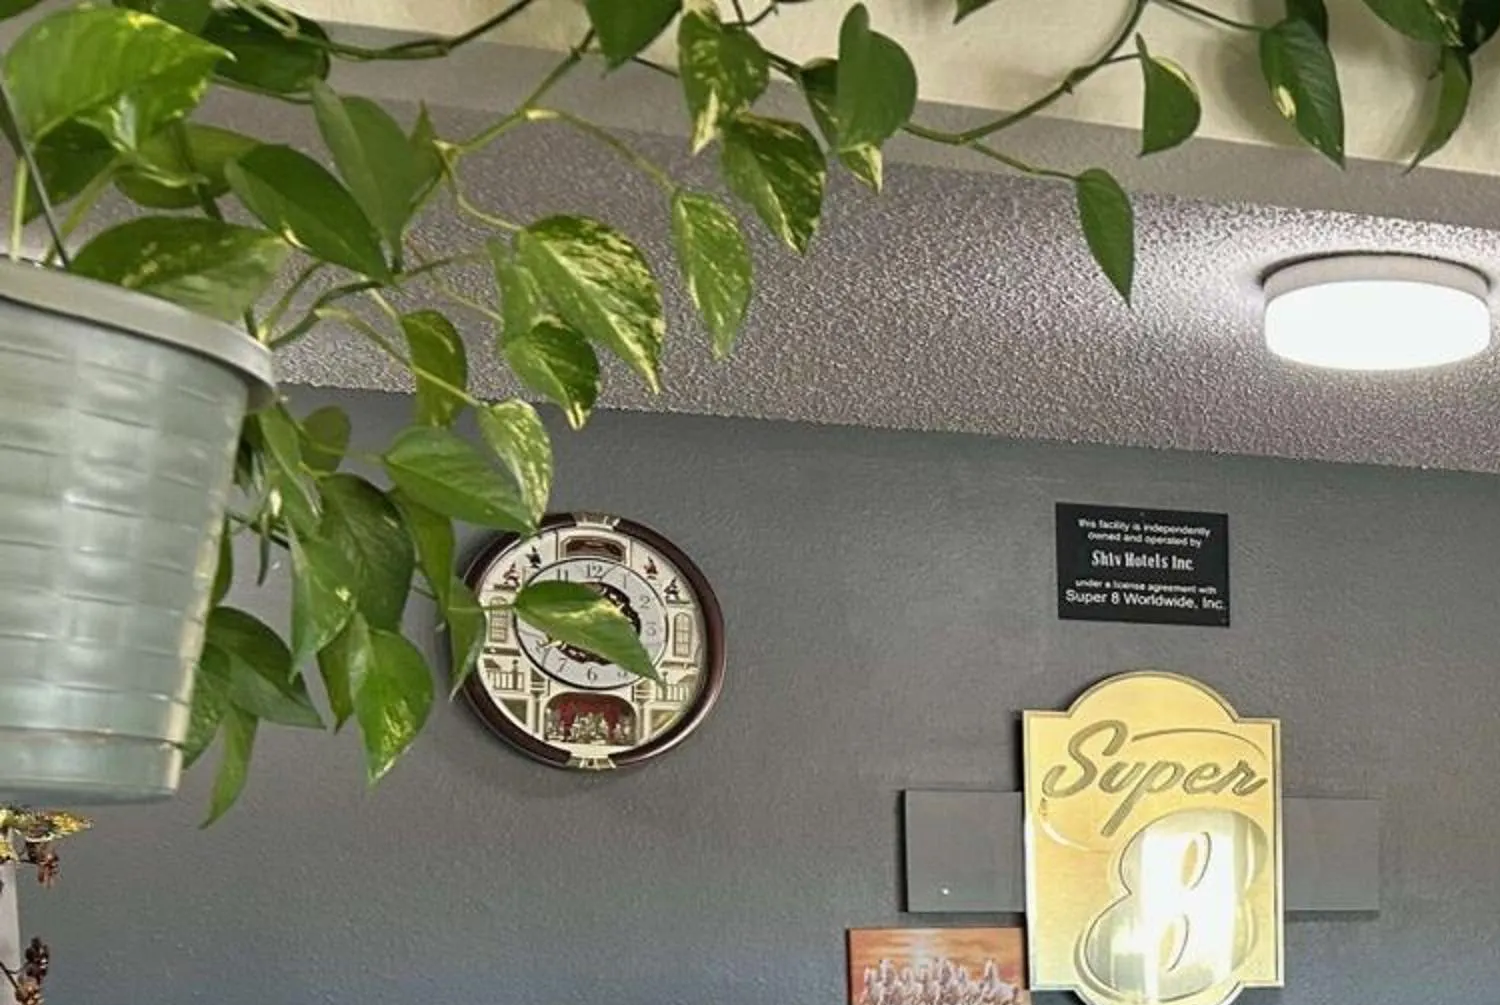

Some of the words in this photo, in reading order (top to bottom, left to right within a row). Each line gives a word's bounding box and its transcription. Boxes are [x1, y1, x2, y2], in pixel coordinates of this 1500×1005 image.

[1099, 519, 1129, 532] facility
[1132, 522, 1142, 531] is
[1143, 523, 1211, 538] independently
[1087, 531, 1121, 541] owned
[1123, 533, 1143, 543] and
[1144, 535, 1189, 547] operated
[1189, 537, 1202, 549] by
[1091, 549, 1122, 567] Shiv
[1124, 551, 1168, 569] Hotels
[586, 563, 603, 579] 12
[1075, 579, 1102, 589] under
[1104, 581, 1111, 589] a
[1112, 580, 1146, 591] license
[1147, 583, 1197, 595] agreement
[1198, 585, 1217, 595] with
[639, 595, 651, 609] 2
[1065, 589, 1108, 605] Super
[1111, 591, 1120, 605] 8
[558, 657, 569, 674] 7
[587, 666, 598, 682] 6
[1041, 719, 1269, 837] Super
[1074, 806, 1269, 1005] 8
